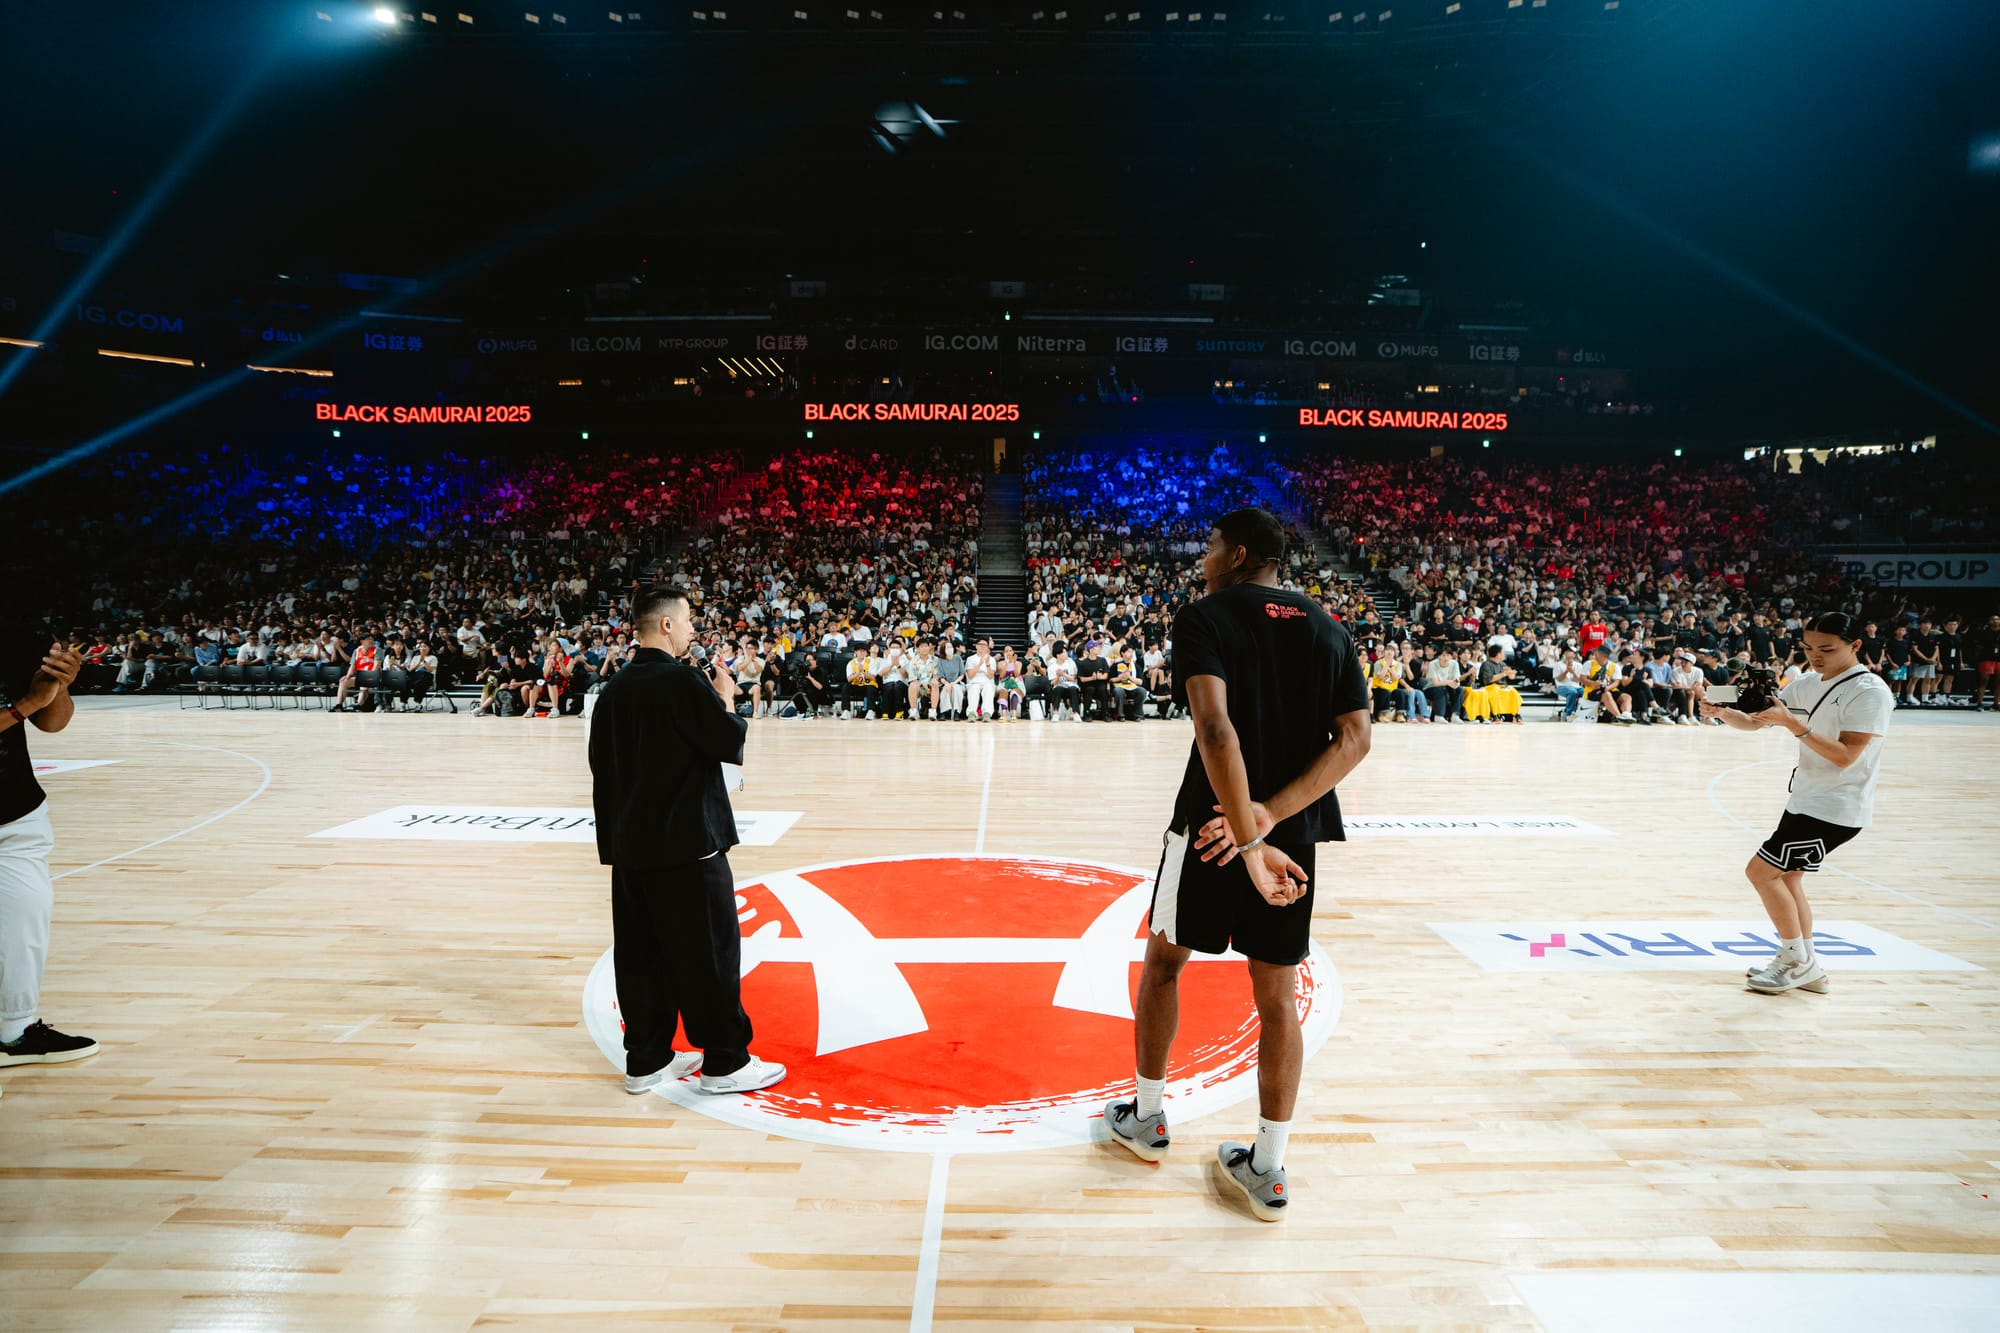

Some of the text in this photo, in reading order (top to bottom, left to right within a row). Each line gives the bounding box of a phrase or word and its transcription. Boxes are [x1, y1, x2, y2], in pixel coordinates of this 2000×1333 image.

[77, 303, 185, 335] IG.COM
[501, 339, 537, 351] MUFG
[571, 337, 641, 352] IG.COM
[756, 335, 808, 351] IG証券
[859, 338, 898, 351] CARD
[925, 335, 999, 351] IG.COM
[1017, 336, 1086, 352] Niterra
[1116, 336, 1169, 353] IG証券
[1284, 340, 1356, 357] IG.COM
[1401, 344, 1438, 357] MUFG
[1469, 344, 1521, 361] IG証券
[315, 403, 531, 423] BLACK SAMURAI 2025
[804, 403, 1020, 421] BLACK SAMURAI 2025
[1299, 408, 1508, 431] BLACK SAMURAI 2025
[1872, 560, 1989, 580] GROUP
